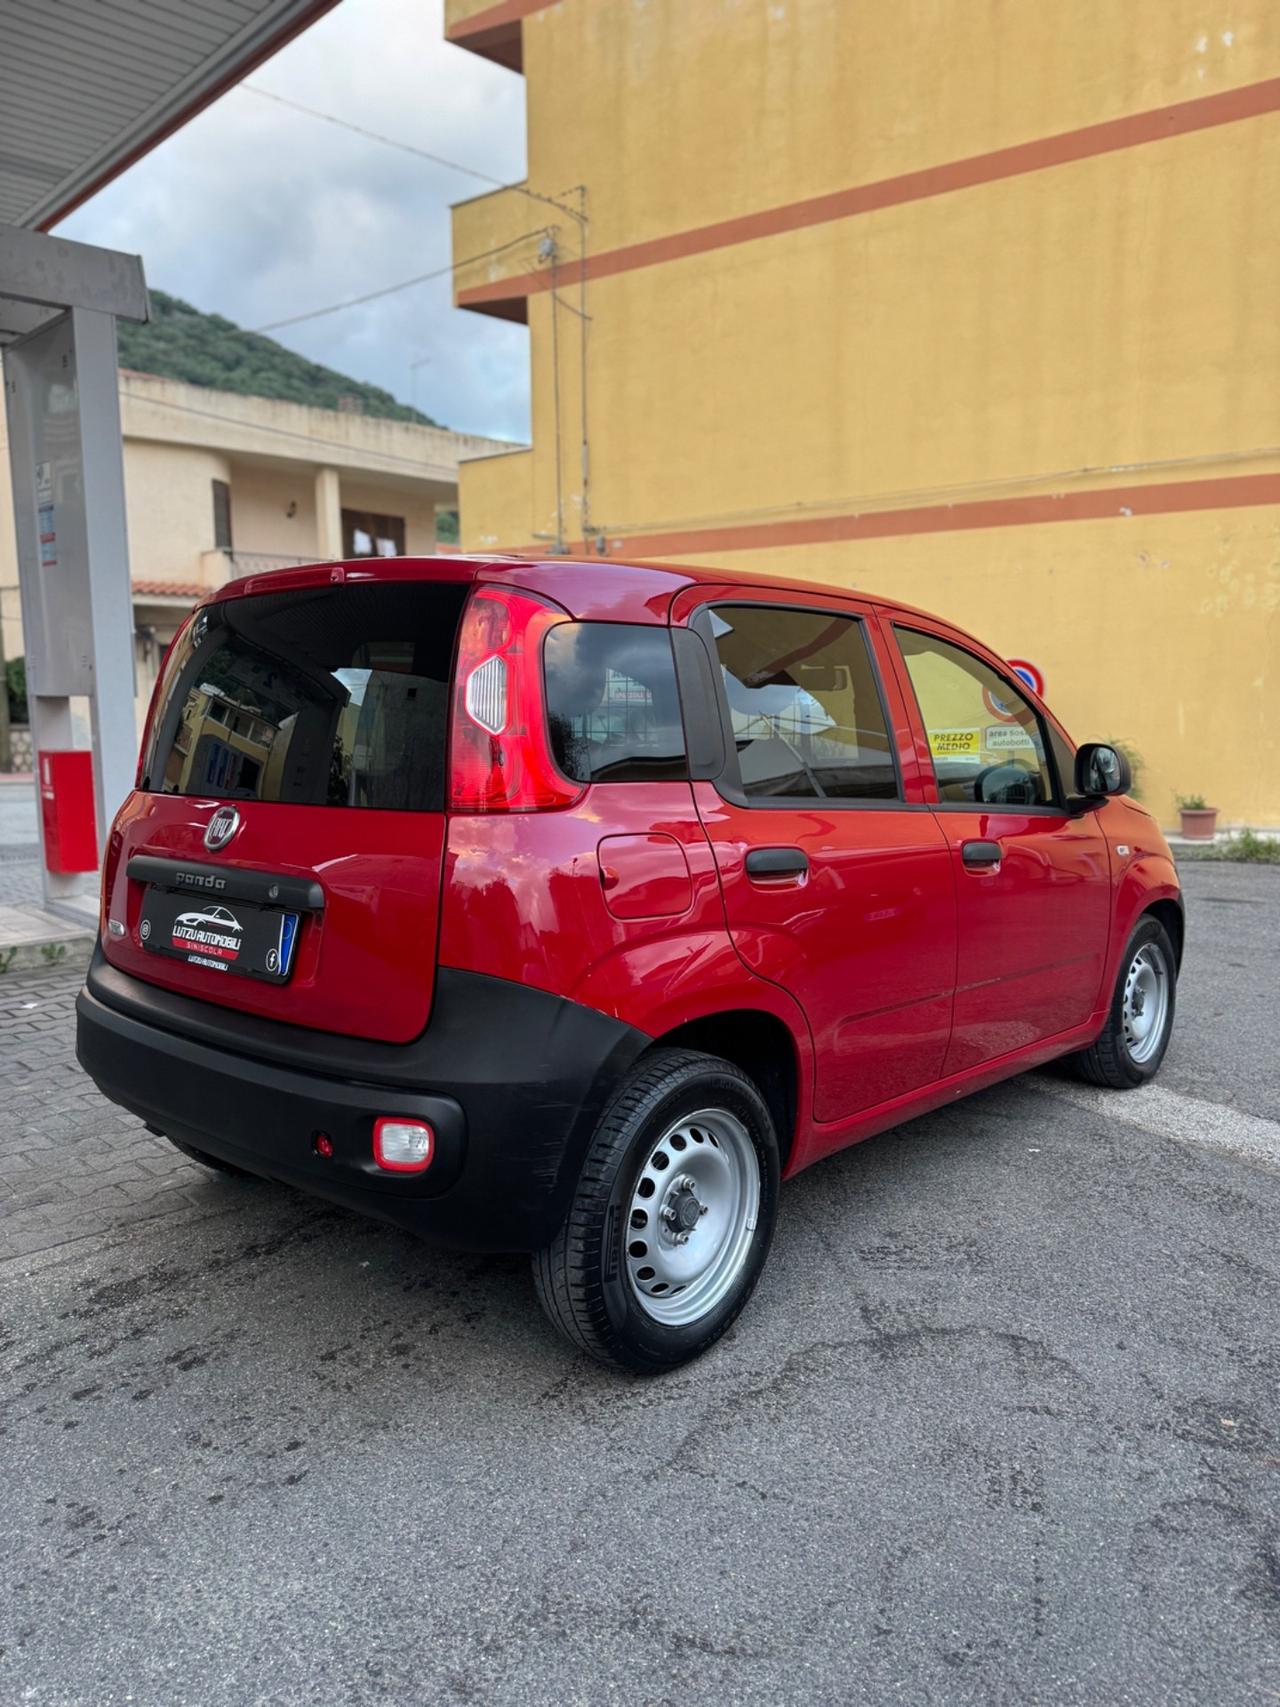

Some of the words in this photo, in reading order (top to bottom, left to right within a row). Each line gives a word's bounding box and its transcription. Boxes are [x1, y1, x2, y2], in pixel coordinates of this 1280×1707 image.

[934, 732, 973, 742] PREZZO
[937, 742, 971, 751] MEDIO
[210, 817, 232, 838] FIAT
[176, 872, 226, 889] panda
[173, 925, 197, 938] LUTZU
[197, 930, 241, 950] AUTOMOBILI
[187, 941, 222, 955] SINISCOLA
